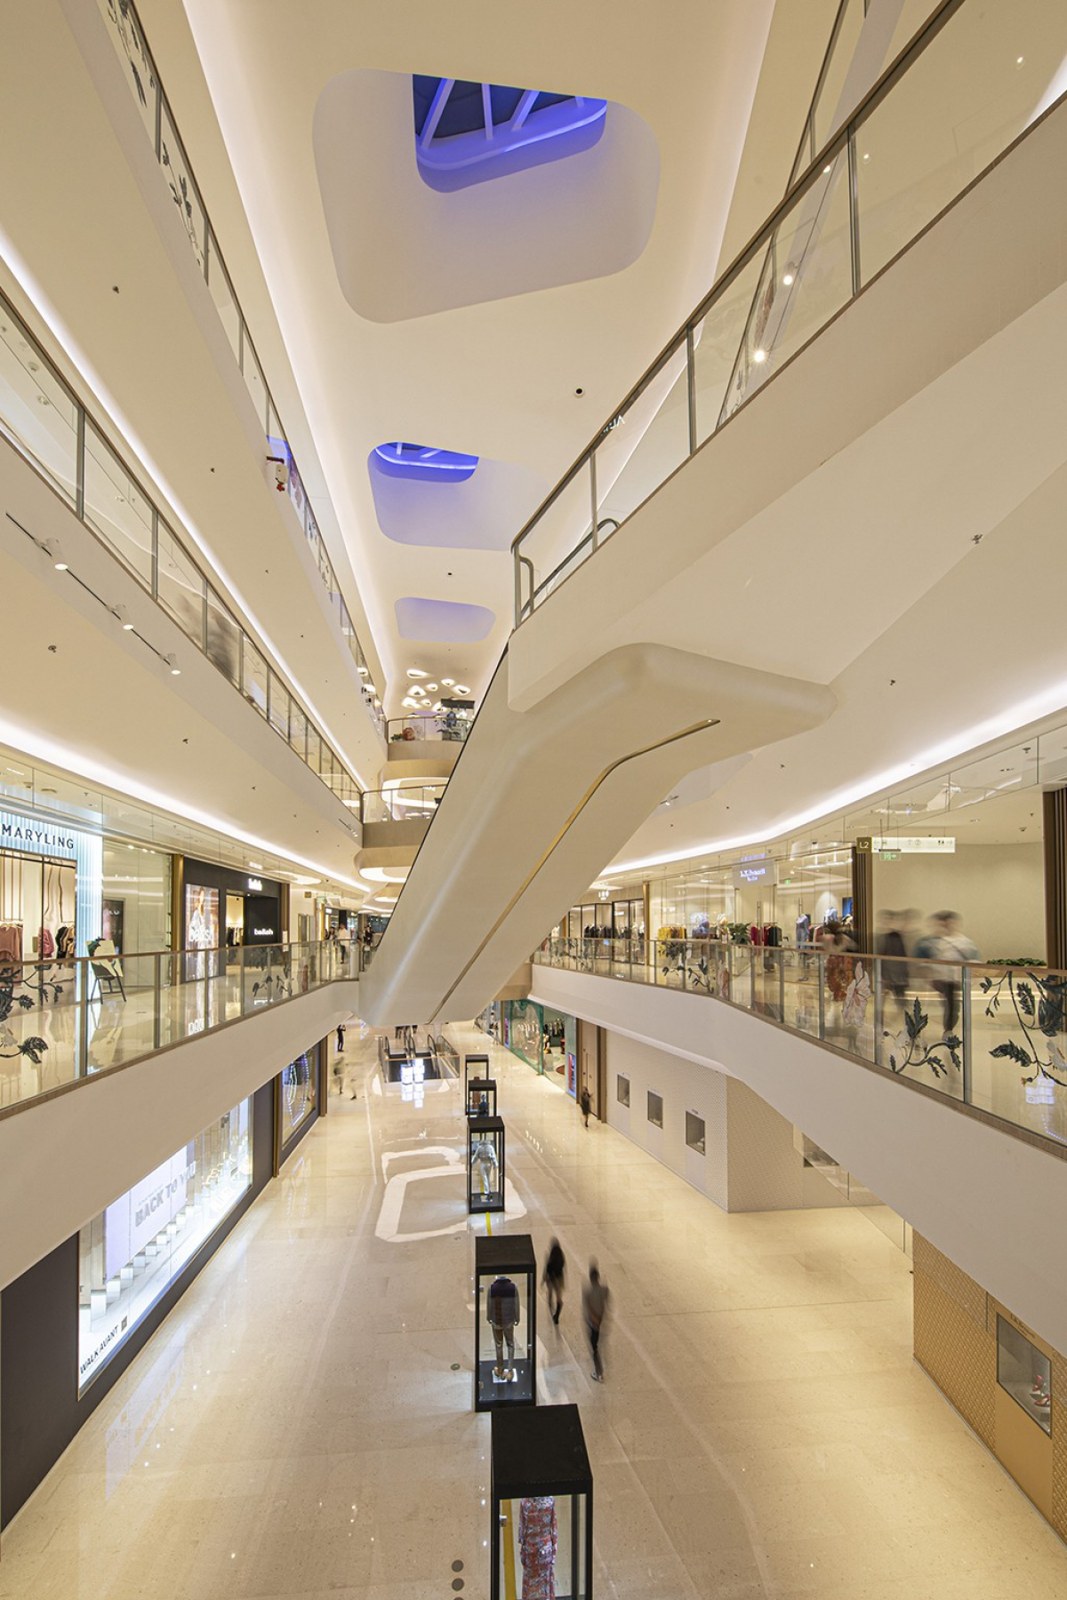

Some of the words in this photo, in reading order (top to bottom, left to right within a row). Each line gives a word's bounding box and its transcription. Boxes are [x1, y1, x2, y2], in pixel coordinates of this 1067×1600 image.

[2, 823, 74, 849] MARYLING
[859, 841, 869, 849] L2
[135, 1189, 164, 1227] BACK
[165, 1178, 178, 1198] TO
